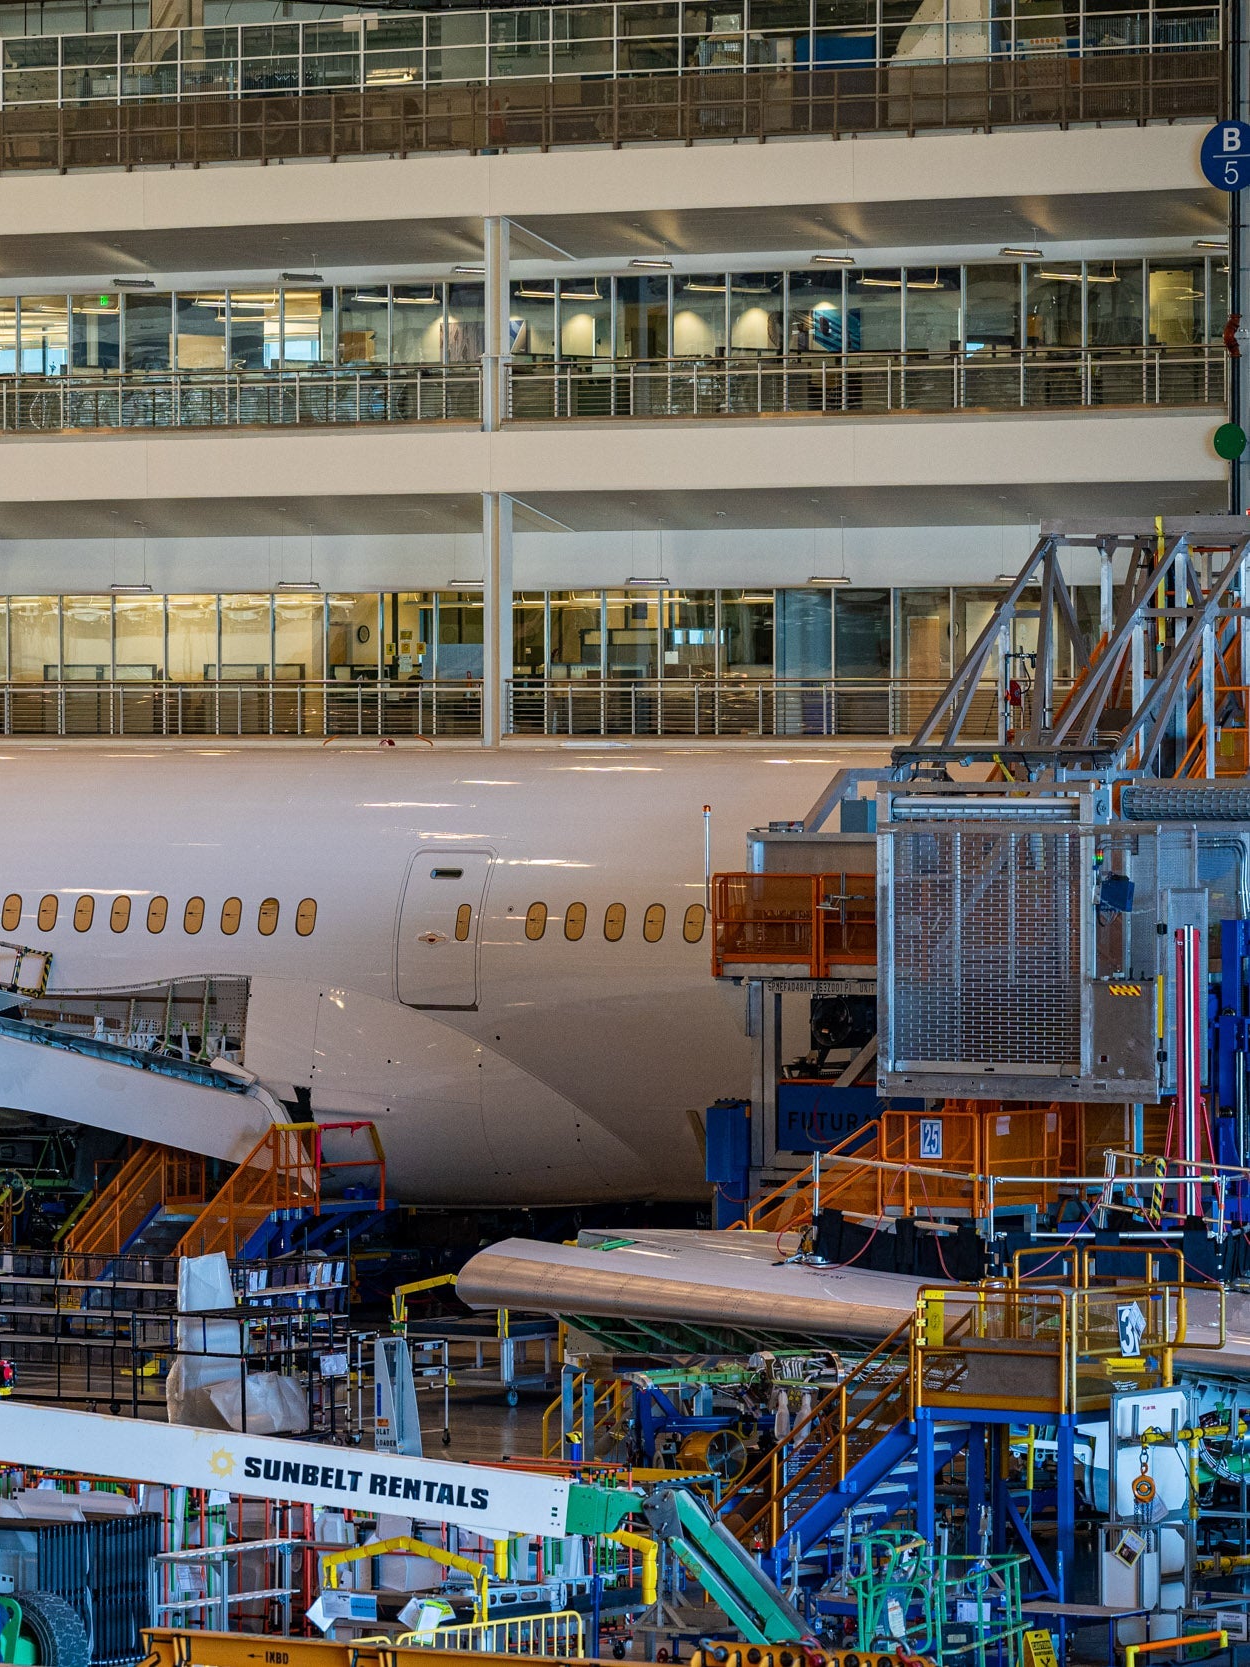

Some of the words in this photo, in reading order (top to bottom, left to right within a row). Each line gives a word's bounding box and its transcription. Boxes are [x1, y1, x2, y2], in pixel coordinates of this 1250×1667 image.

[1223, 127, 1241, 151] B
[1224, 161, 1239, 185] 5
[924, 1123, 938, 1153] 25
[244, 1456, 363, 1492] SUNBELT
[369, 1473, 490, 1510] RENTALS
[265, 1650, 289, 1664] INBD
